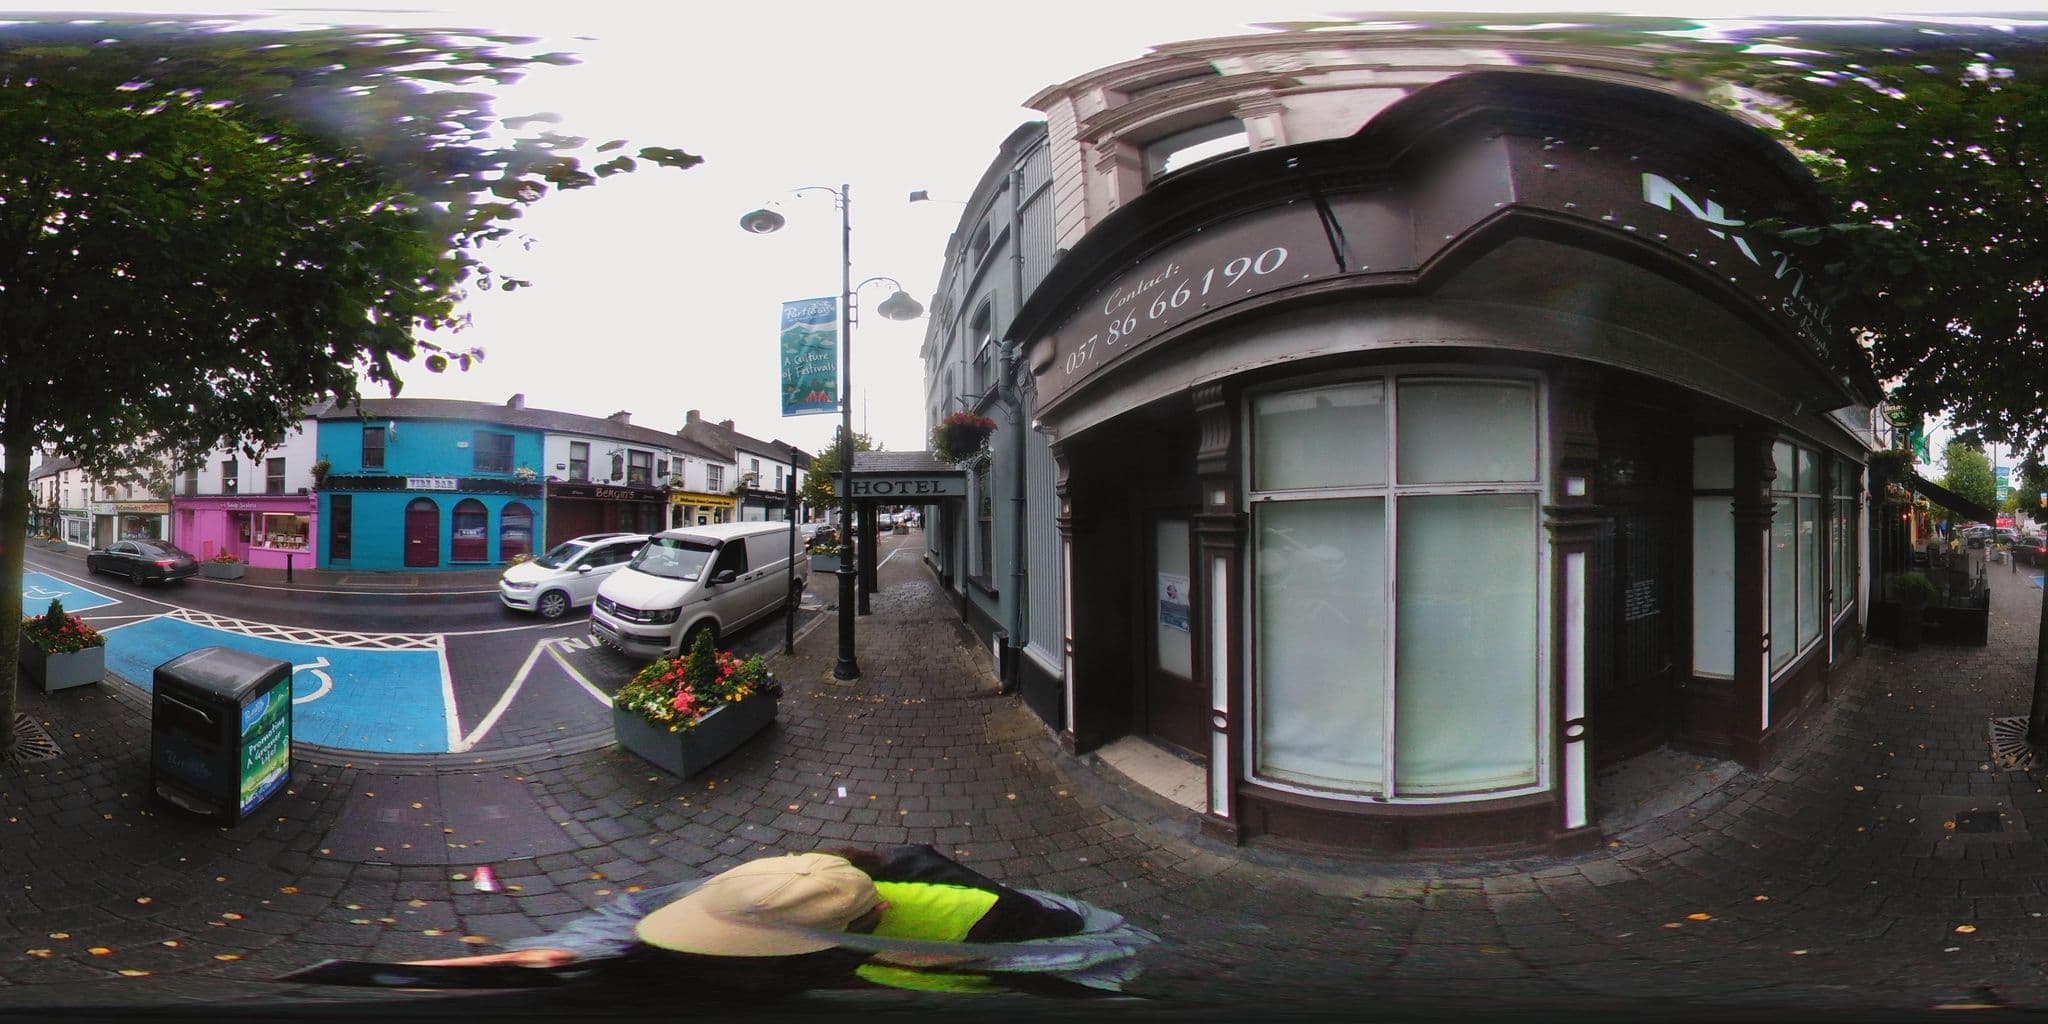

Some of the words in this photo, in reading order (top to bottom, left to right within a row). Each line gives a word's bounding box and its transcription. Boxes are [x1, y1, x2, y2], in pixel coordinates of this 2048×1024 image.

[1104, 263, 1180, 315] Contact:
[1065, 334, 1098, 375] 057
[1106, 308, 1137, 345] 86
[1149, 247, 1288, 319] 66190
[783, 368, 792, 381] of
[796, 364, 836, 378] Festivals
[784, 357, 791, 367] A
[794, 353, 829, 365] Culture
[853, 480, 947, 495] HOTEL
[246, 758, 253, 769] A
[255, 731, 281, 761] Greener
[248, 716, 285, 756] Promoting
